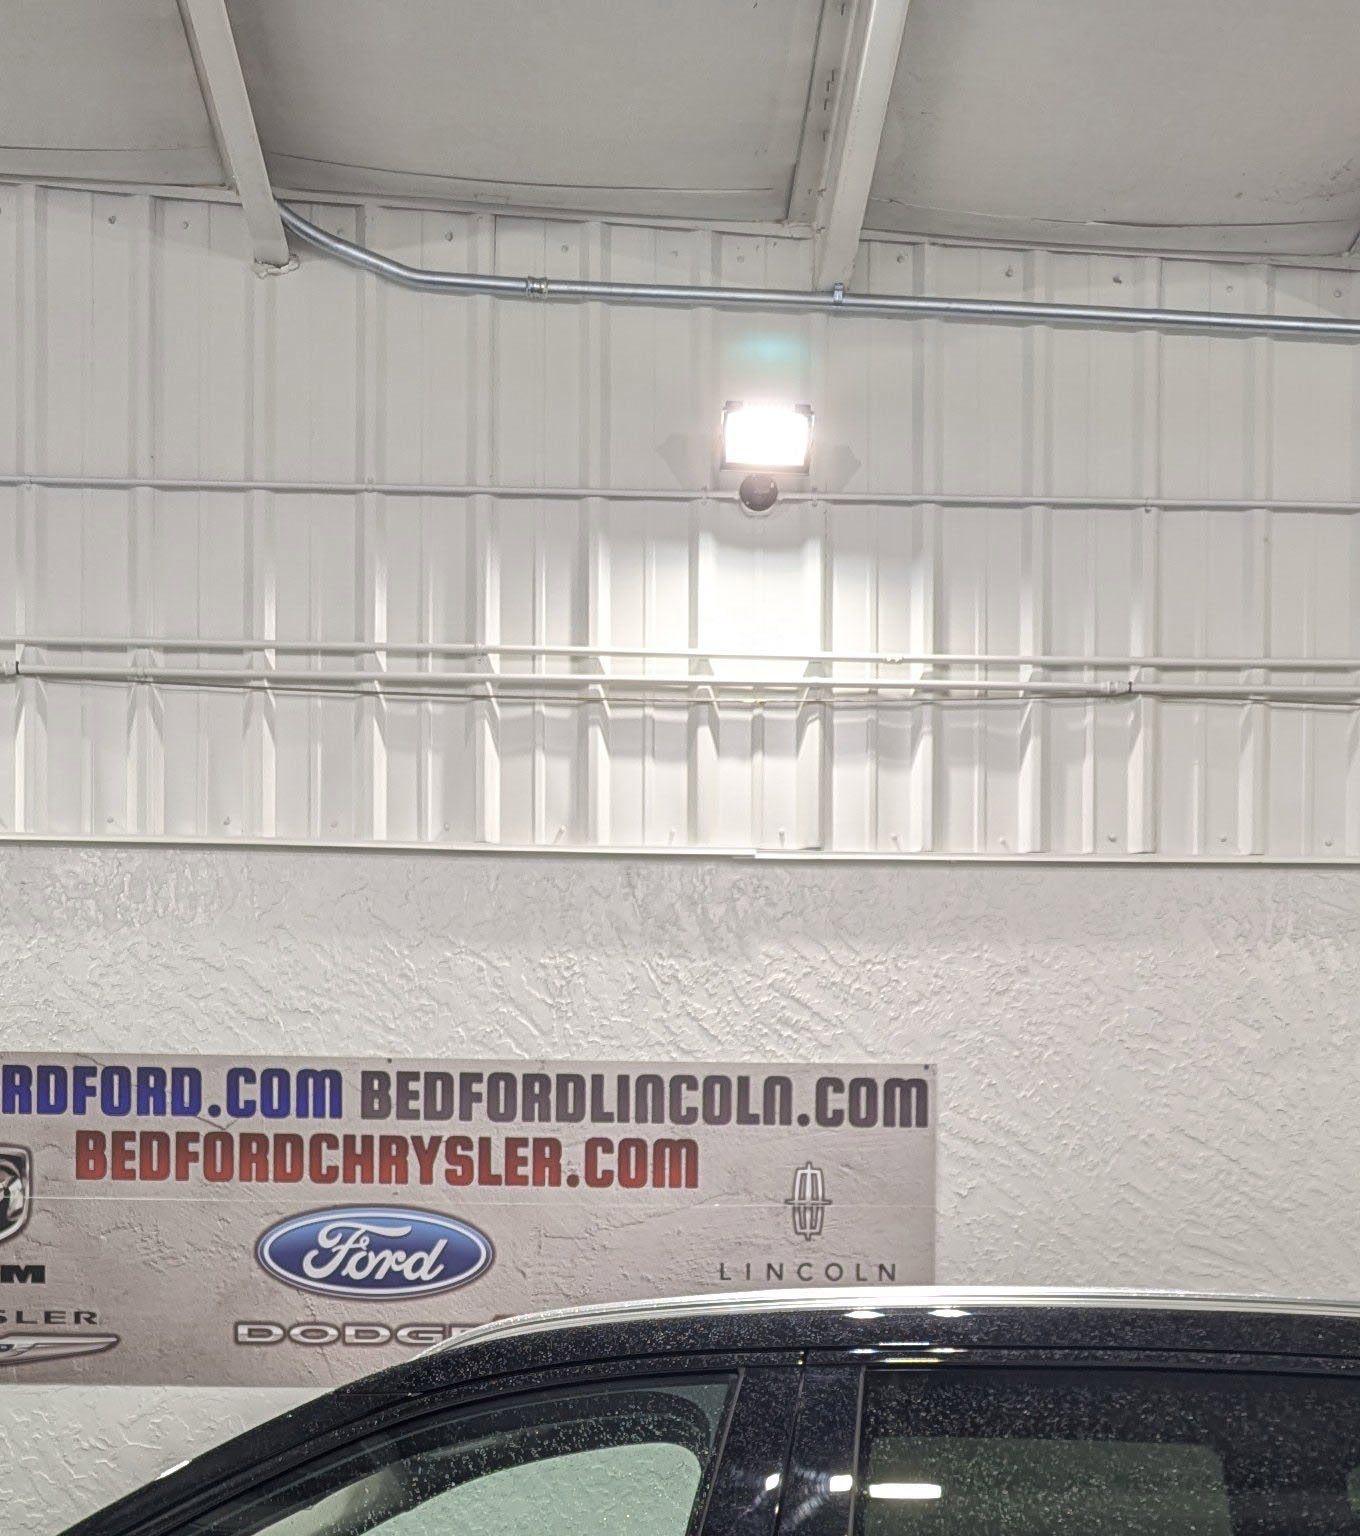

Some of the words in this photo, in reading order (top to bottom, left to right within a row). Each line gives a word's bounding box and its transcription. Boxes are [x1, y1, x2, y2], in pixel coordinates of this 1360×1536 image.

[360, 1070, 928, 1128] BEDFORDLINCOLN.COM
[75, 1130, 698, 1188] BEDFORDCHRYSLER.COM
[302, 1224, 447, 1284] Ford
[719, 1262, 896, 1282] LINCOLN
